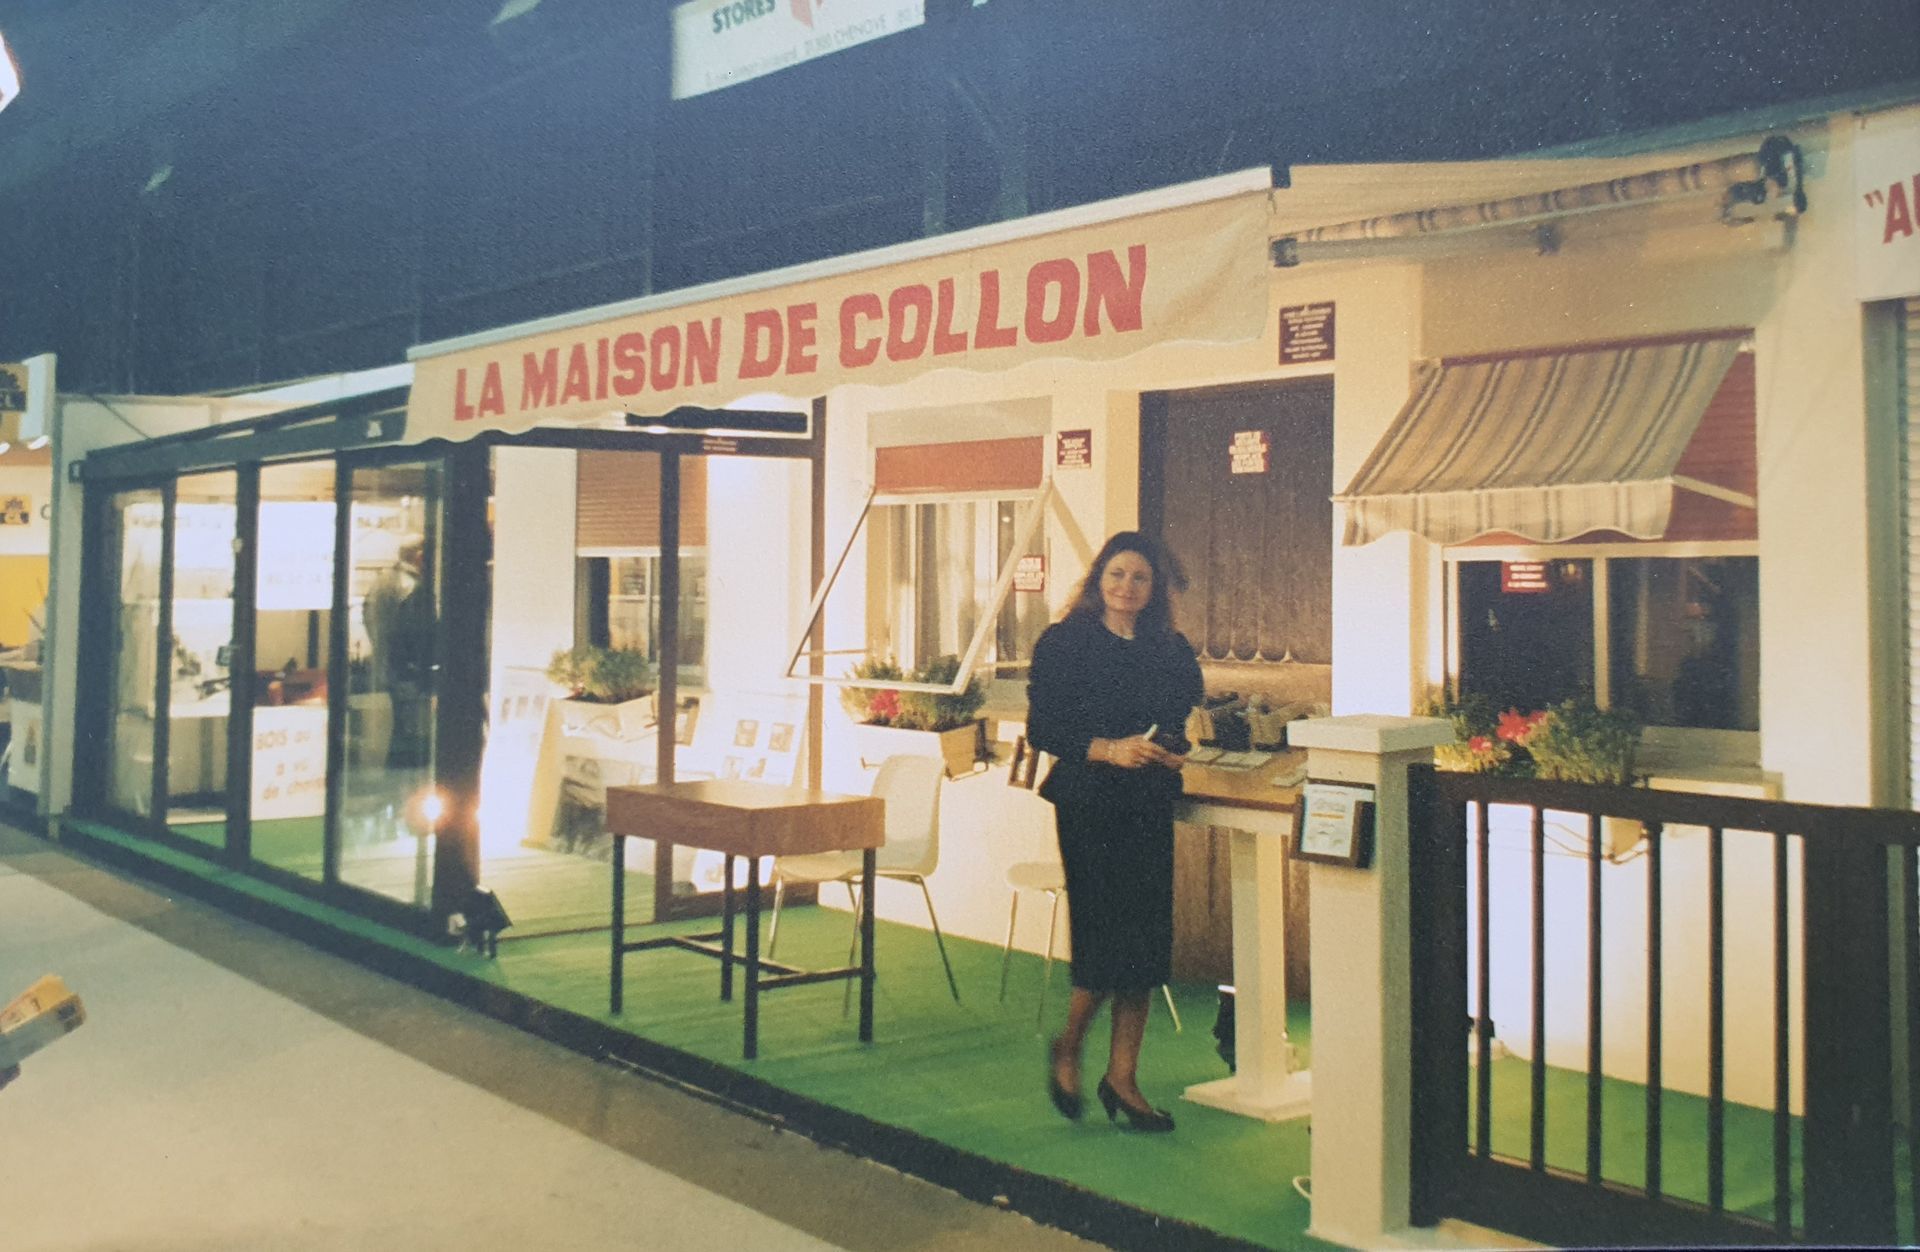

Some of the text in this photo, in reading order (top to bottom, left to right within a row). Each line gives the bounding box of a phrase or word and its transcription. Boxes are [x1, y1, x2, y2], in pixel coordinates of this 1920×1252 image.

[712, 0, 776, 34] STORES
[454, 244, 1147, 421] LA MAISON DE COLLON
